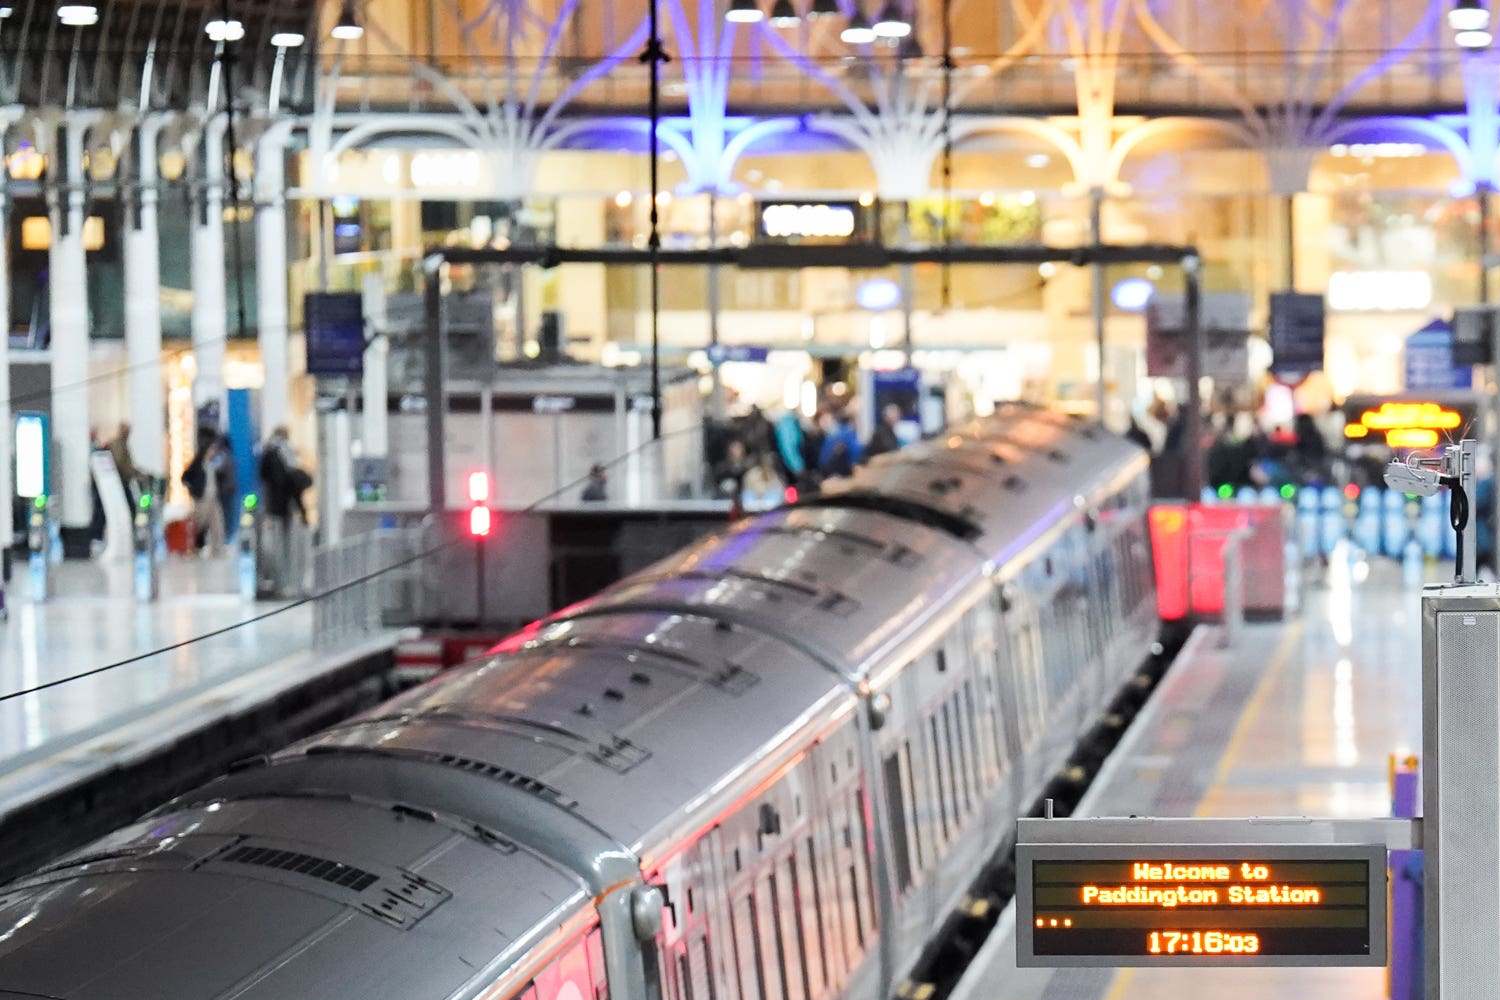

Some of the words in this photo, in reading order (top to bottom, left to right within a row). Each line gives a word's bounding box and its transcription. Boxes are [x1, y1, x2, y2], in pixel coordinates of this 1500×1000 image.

[1133, 862, 1230, 881] Welcome
[1241, 862, 1269, 881] to
[1082, 885, 1218, 907] Paddington
[1228, 885, 1320, 904] Station
[1148, 931, 1260, 953] 17:16:03
